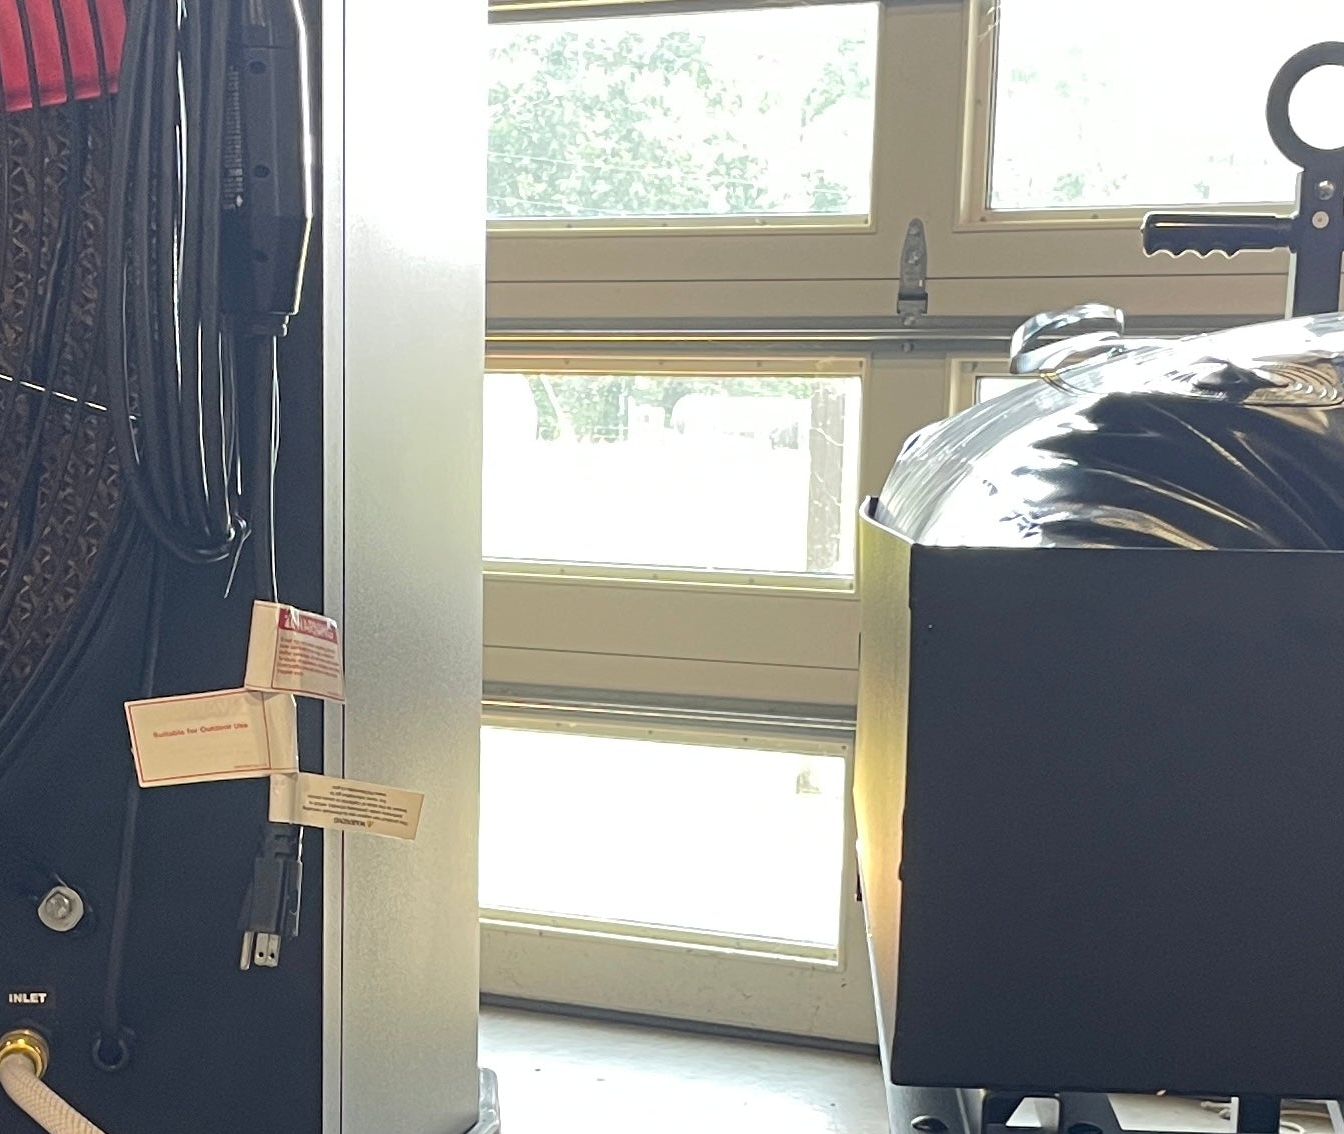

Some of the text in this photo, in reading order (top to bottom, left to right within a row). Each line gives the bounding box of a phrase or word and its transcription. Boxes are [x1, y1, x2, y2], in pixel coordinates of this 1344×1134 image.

[186, 727, 198, 735] for
[199, 724, 232, 733] Outdoor
[233, 722, 249, 730] Use
[8, 992, 47, 1003] INLET
